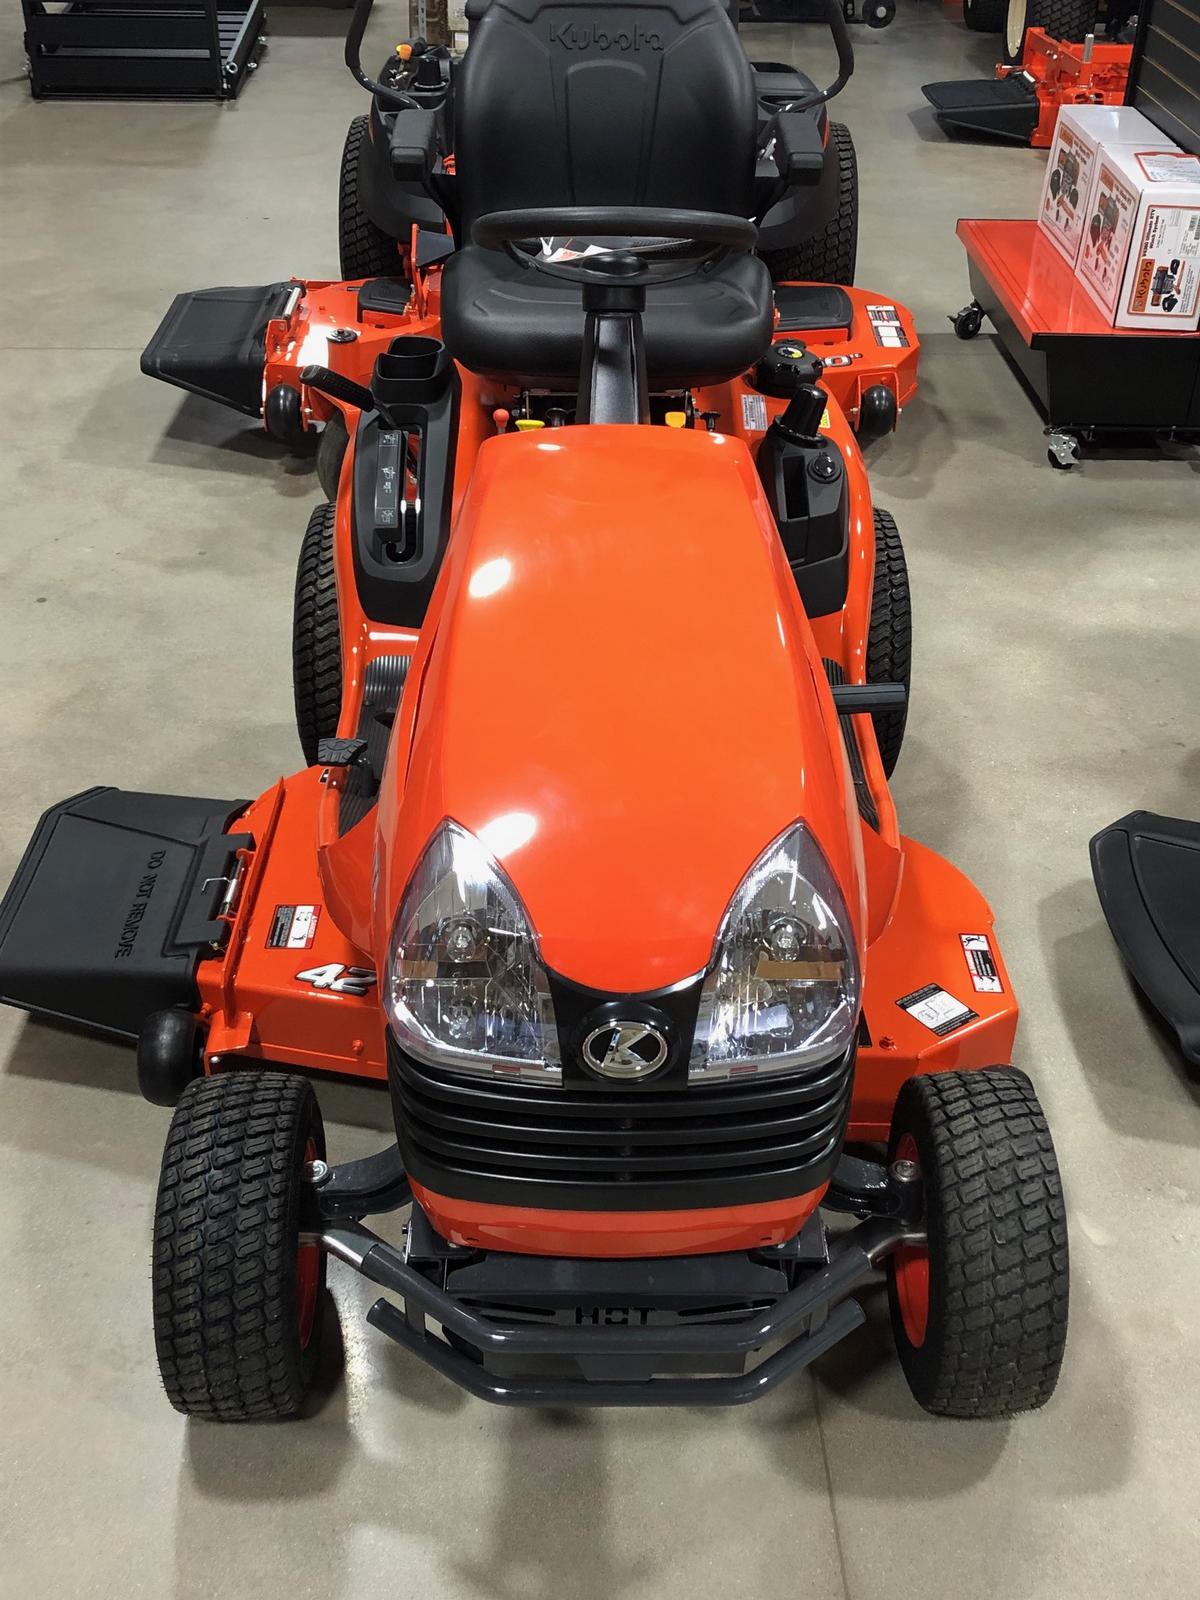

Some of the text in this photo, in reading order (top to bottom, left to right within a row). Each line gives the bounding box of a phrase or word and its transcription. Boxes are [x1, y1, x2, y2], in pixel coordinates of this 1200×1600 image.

[549, 22, 664, 51] Kubota
[1137, 261, 1152, 299] Kubota
[114, 850, 166, 959] DO NOT REMOVE
